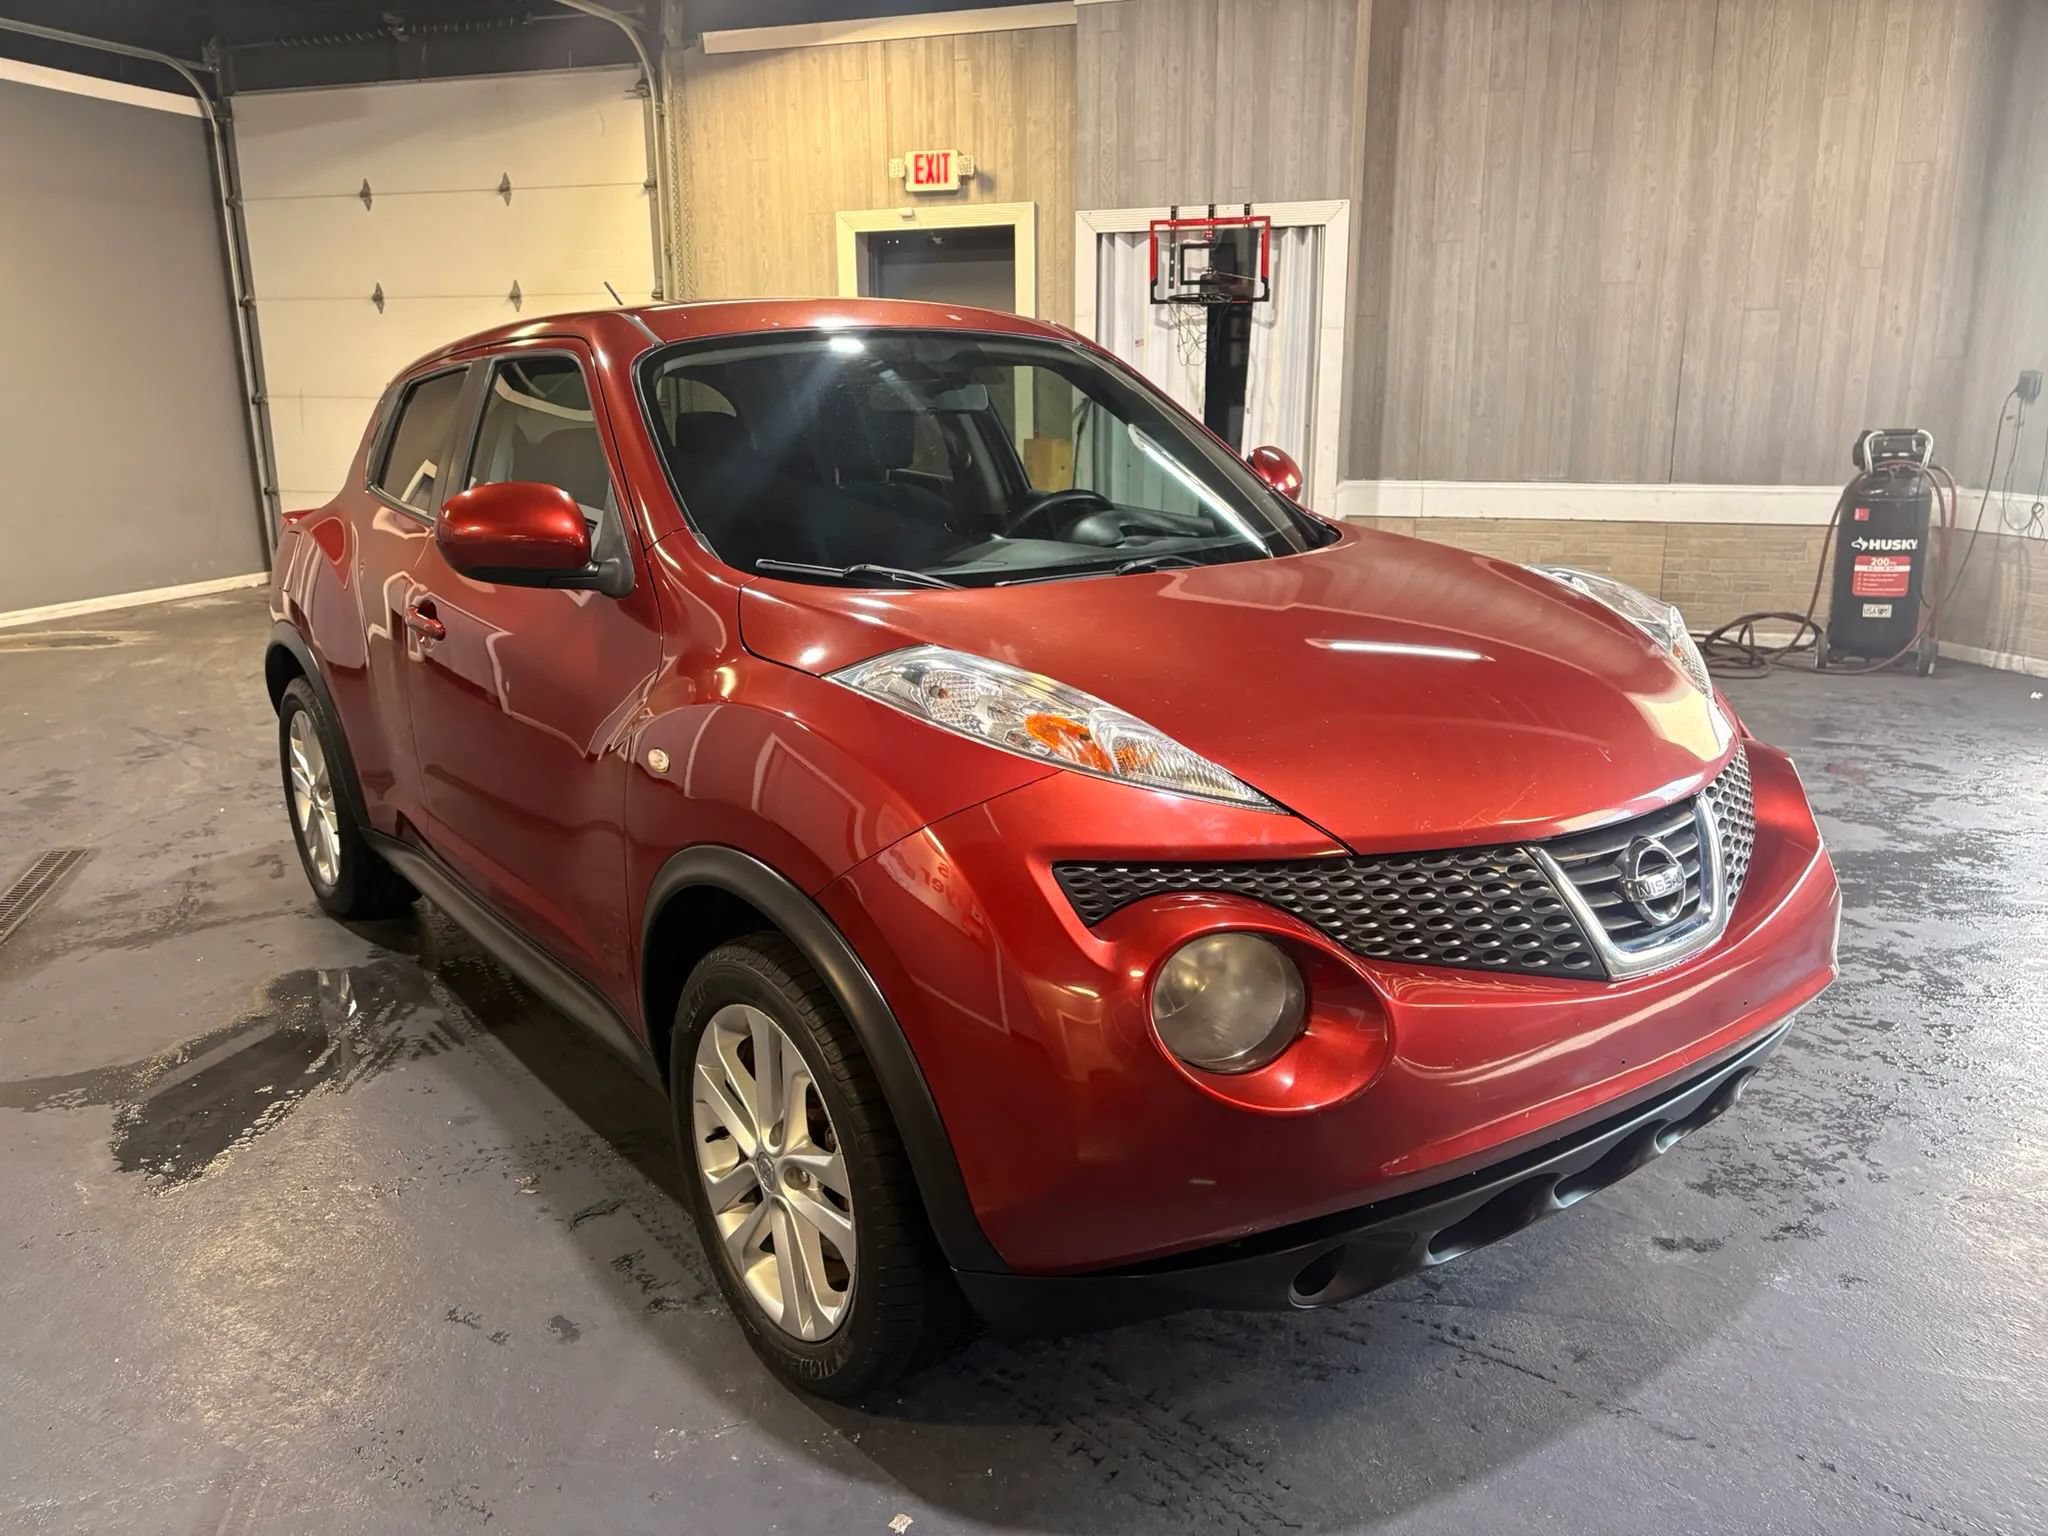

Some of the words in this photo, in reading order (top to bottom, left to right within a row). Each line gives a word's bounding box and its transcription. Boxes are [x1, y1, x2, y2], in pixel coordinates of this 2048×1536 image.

[914, 153, 950, 184] EXIT
[1868, 538, 1918, 551] HUSKY
[1870, 557, 1890, 567] 200
[1637, 869, 1684, 899] NISSAN
